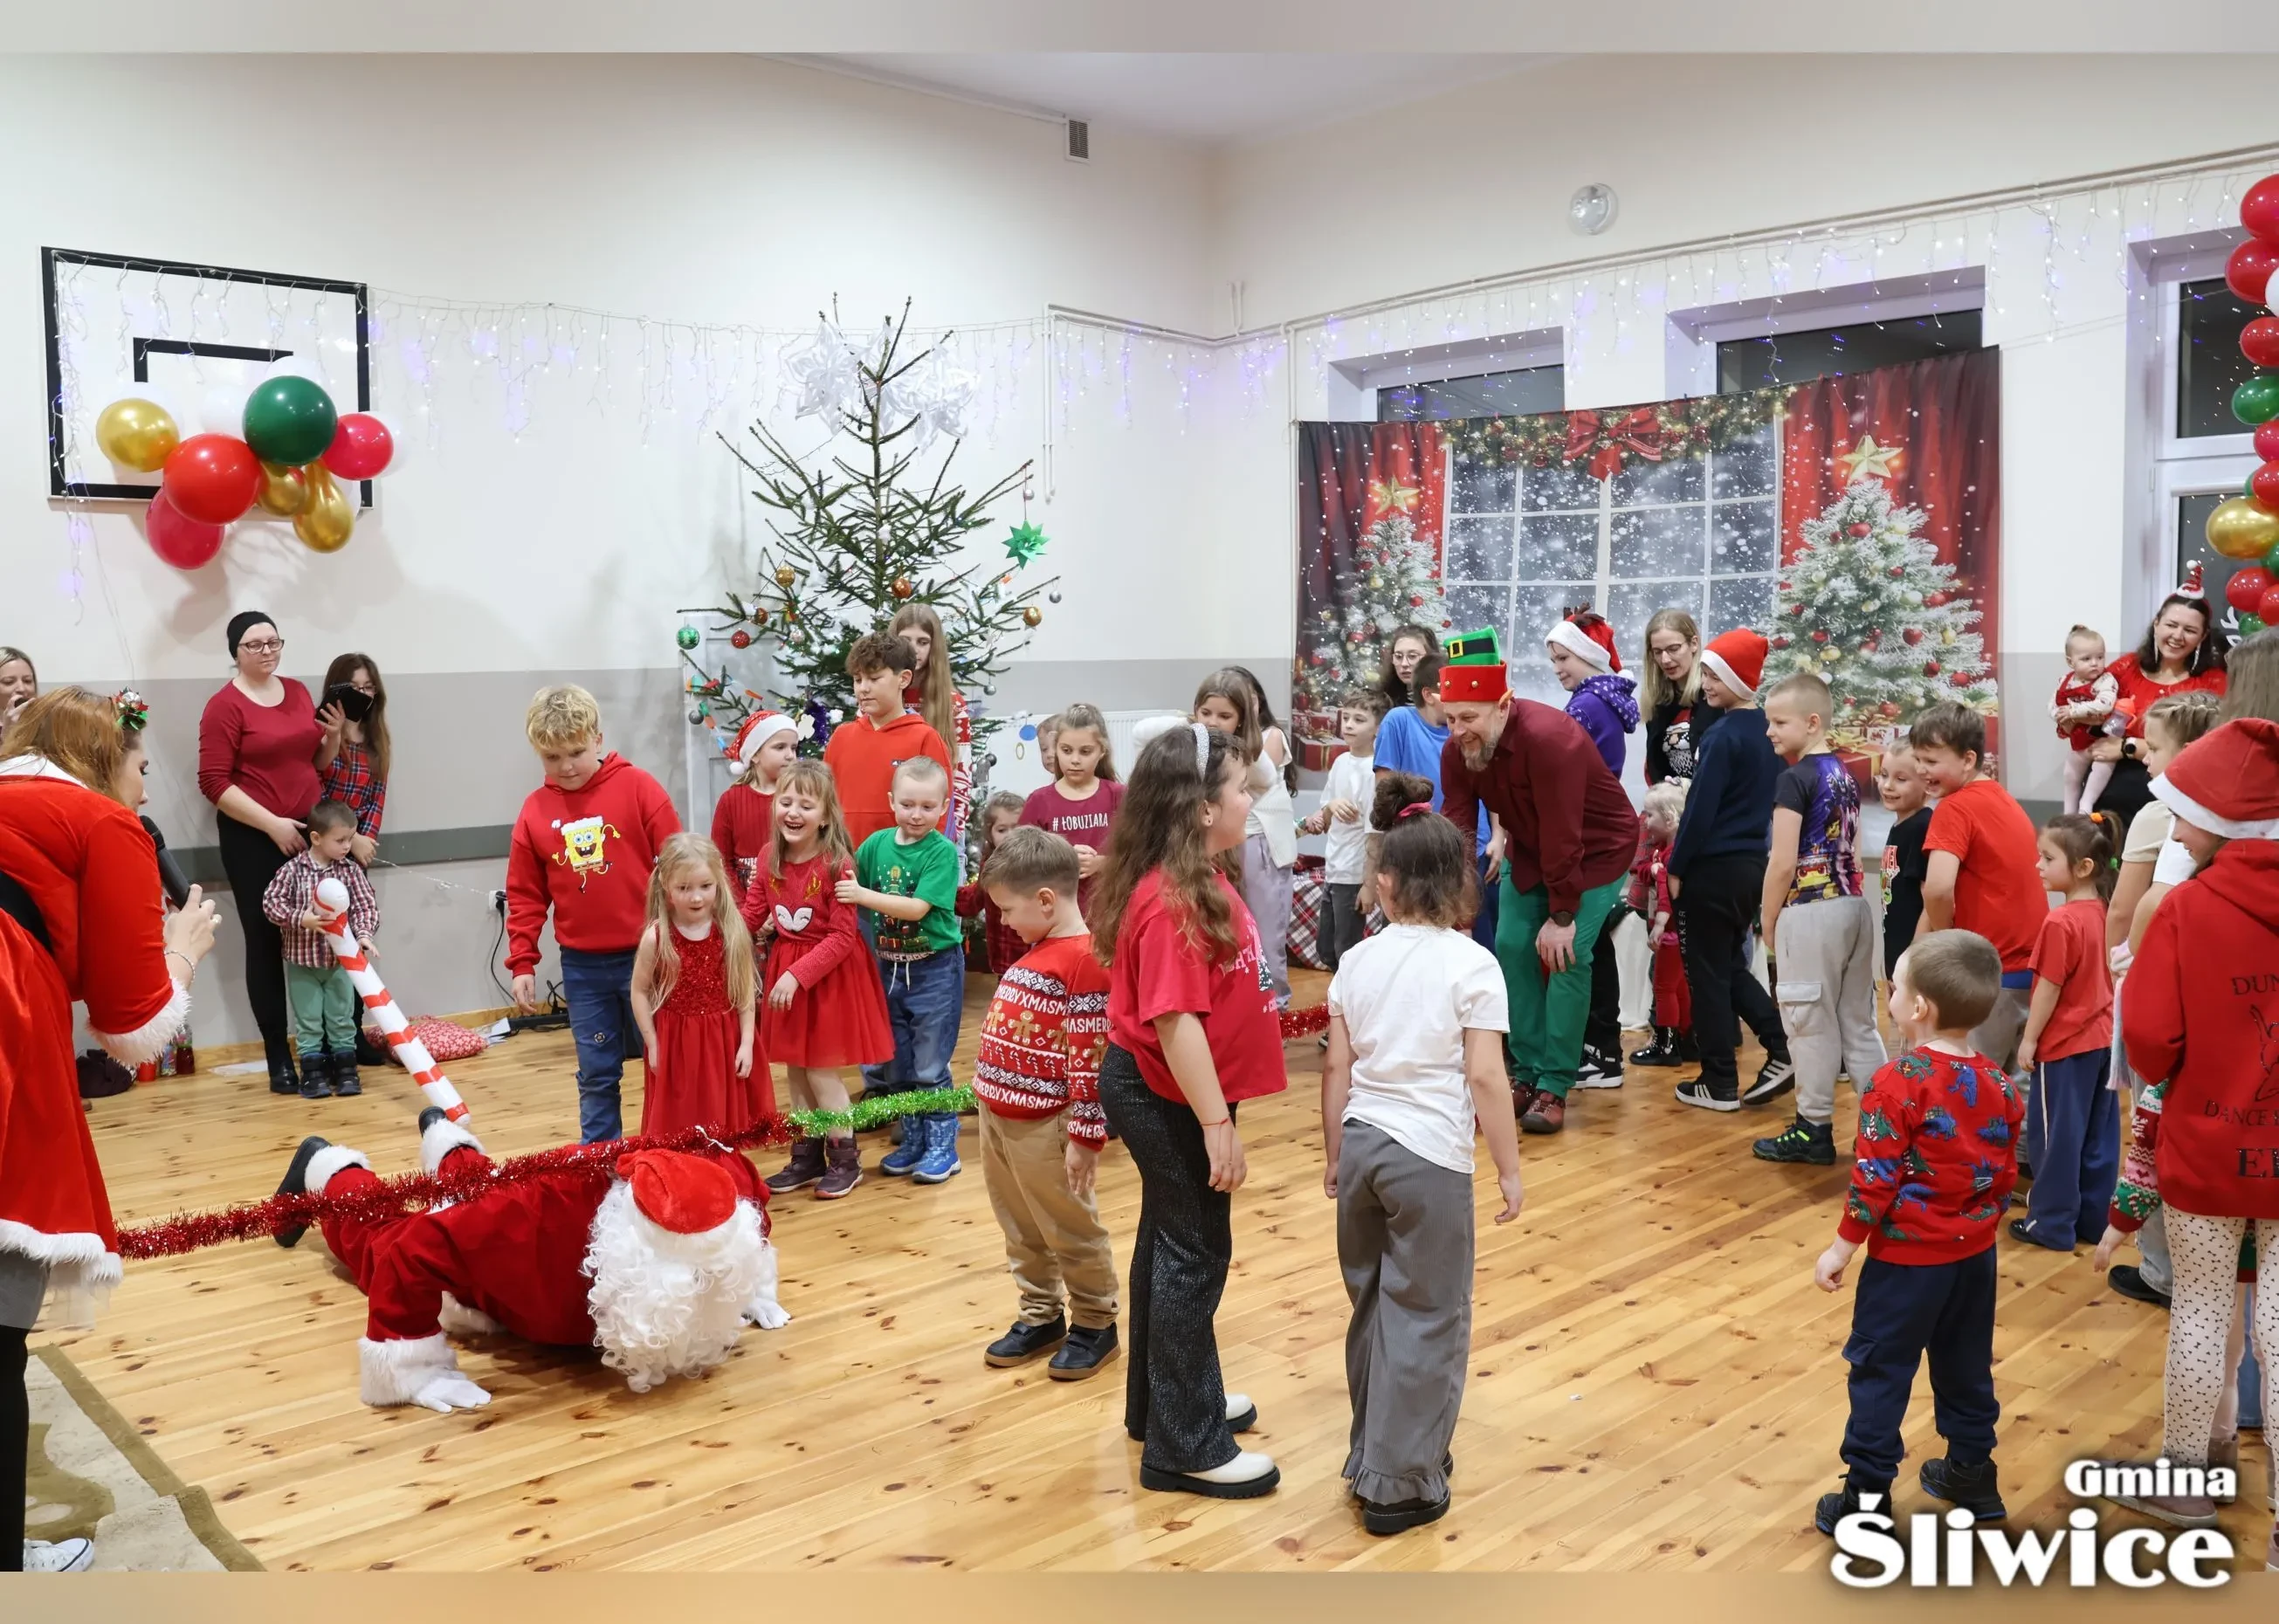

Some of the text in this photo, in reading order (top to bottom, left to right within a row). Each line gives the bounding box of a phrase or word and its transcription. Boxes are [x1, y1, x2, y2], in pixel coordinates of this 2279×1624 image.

[1062, 812, 1109, 831] ŁOBUZIARA
[1678, 910, 1687, 954] MAKER
[2204, 1099, 2269, 1126] DANCE
